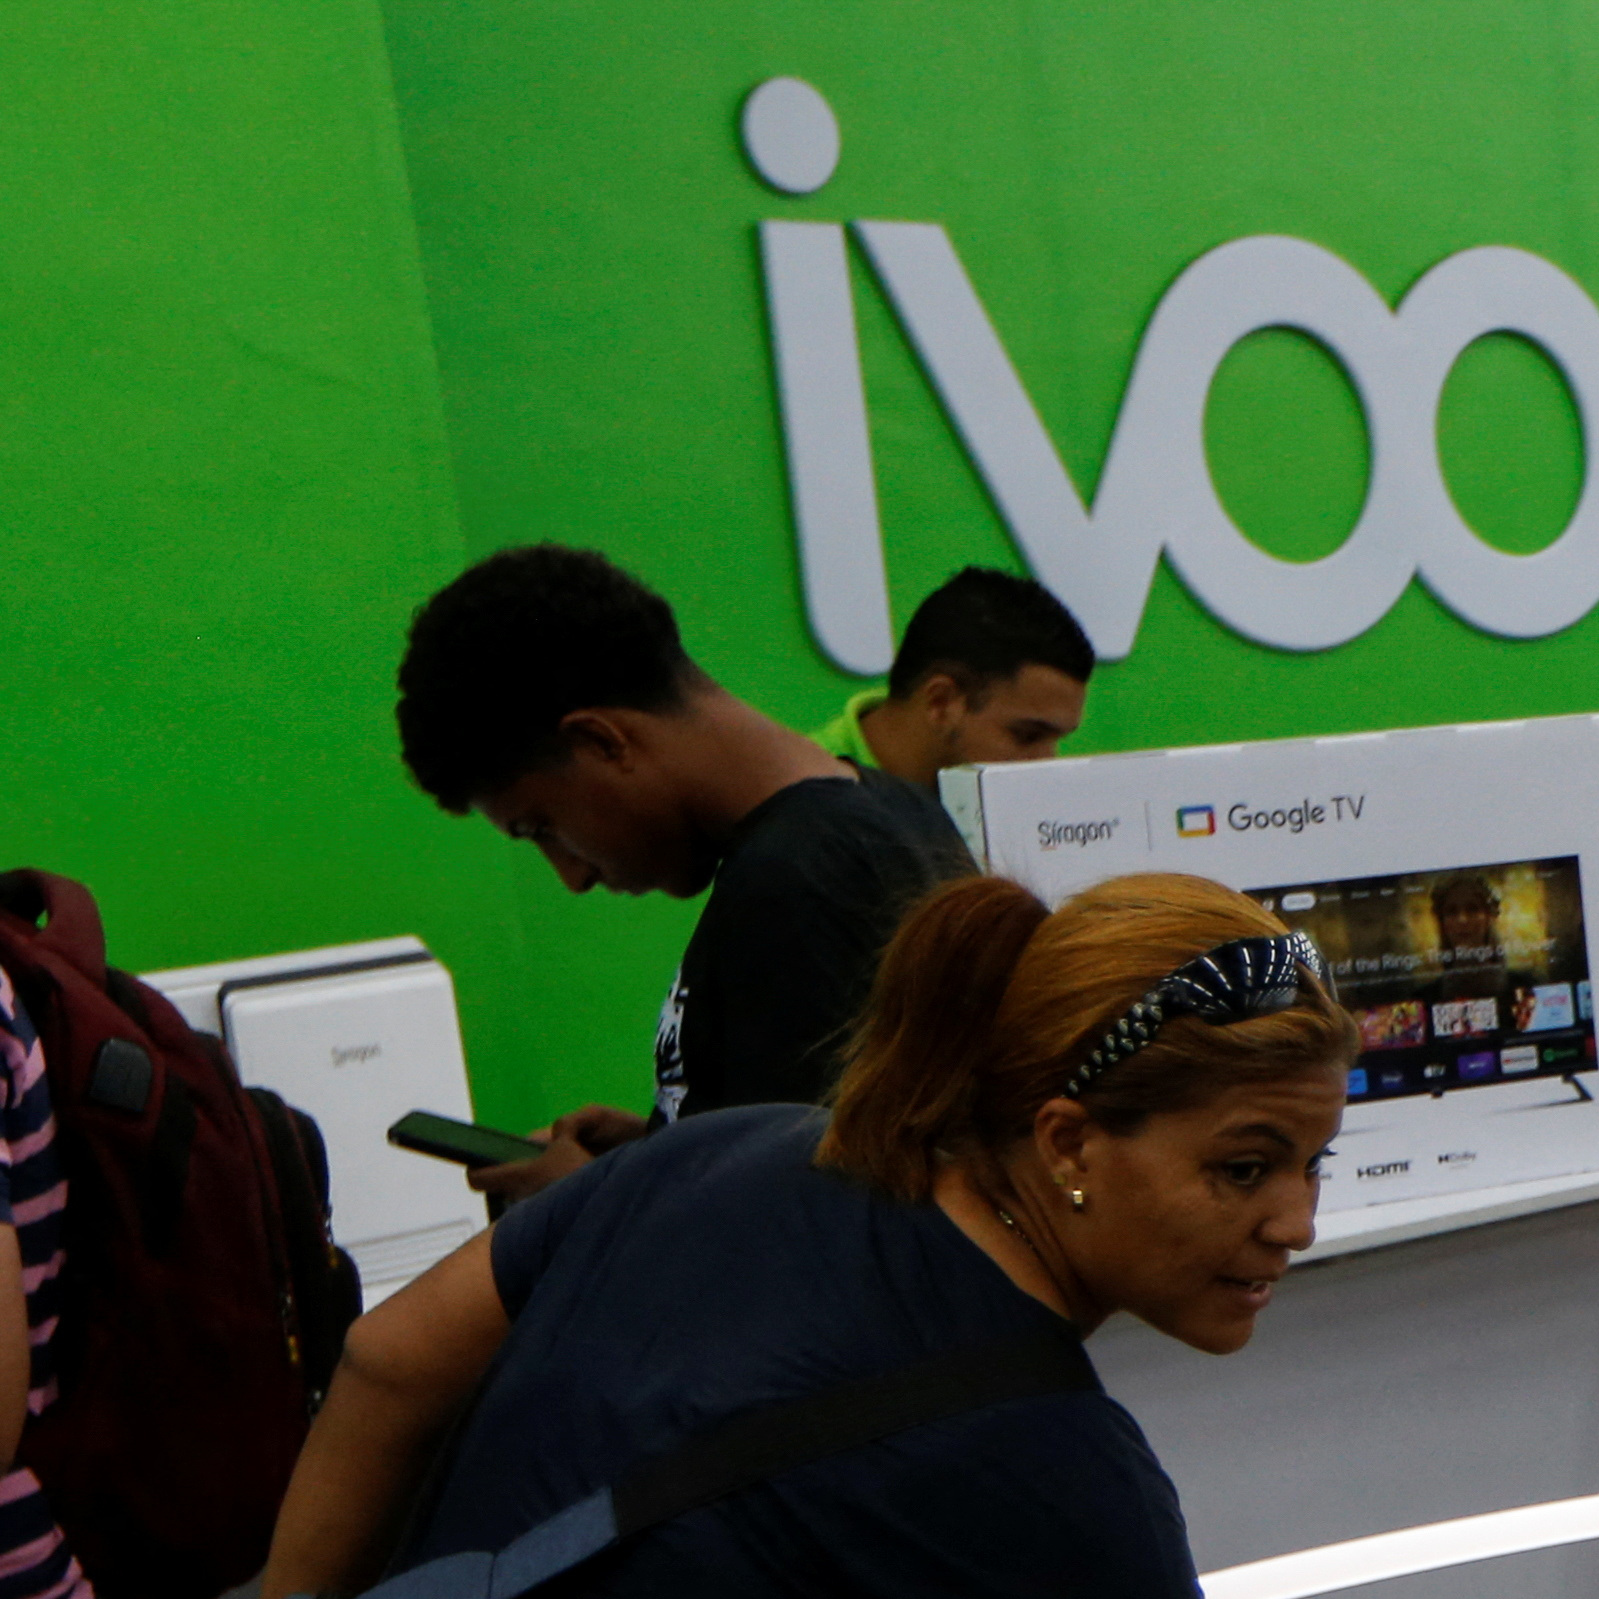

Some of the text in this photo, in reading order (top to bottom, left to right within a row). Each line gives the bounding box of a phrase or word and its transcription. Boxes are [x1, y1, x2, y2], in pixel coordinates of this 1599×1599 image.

[1227, 795, 1366, 834] Google TV
[1356, 1159, 1411, 1179] HDMI
